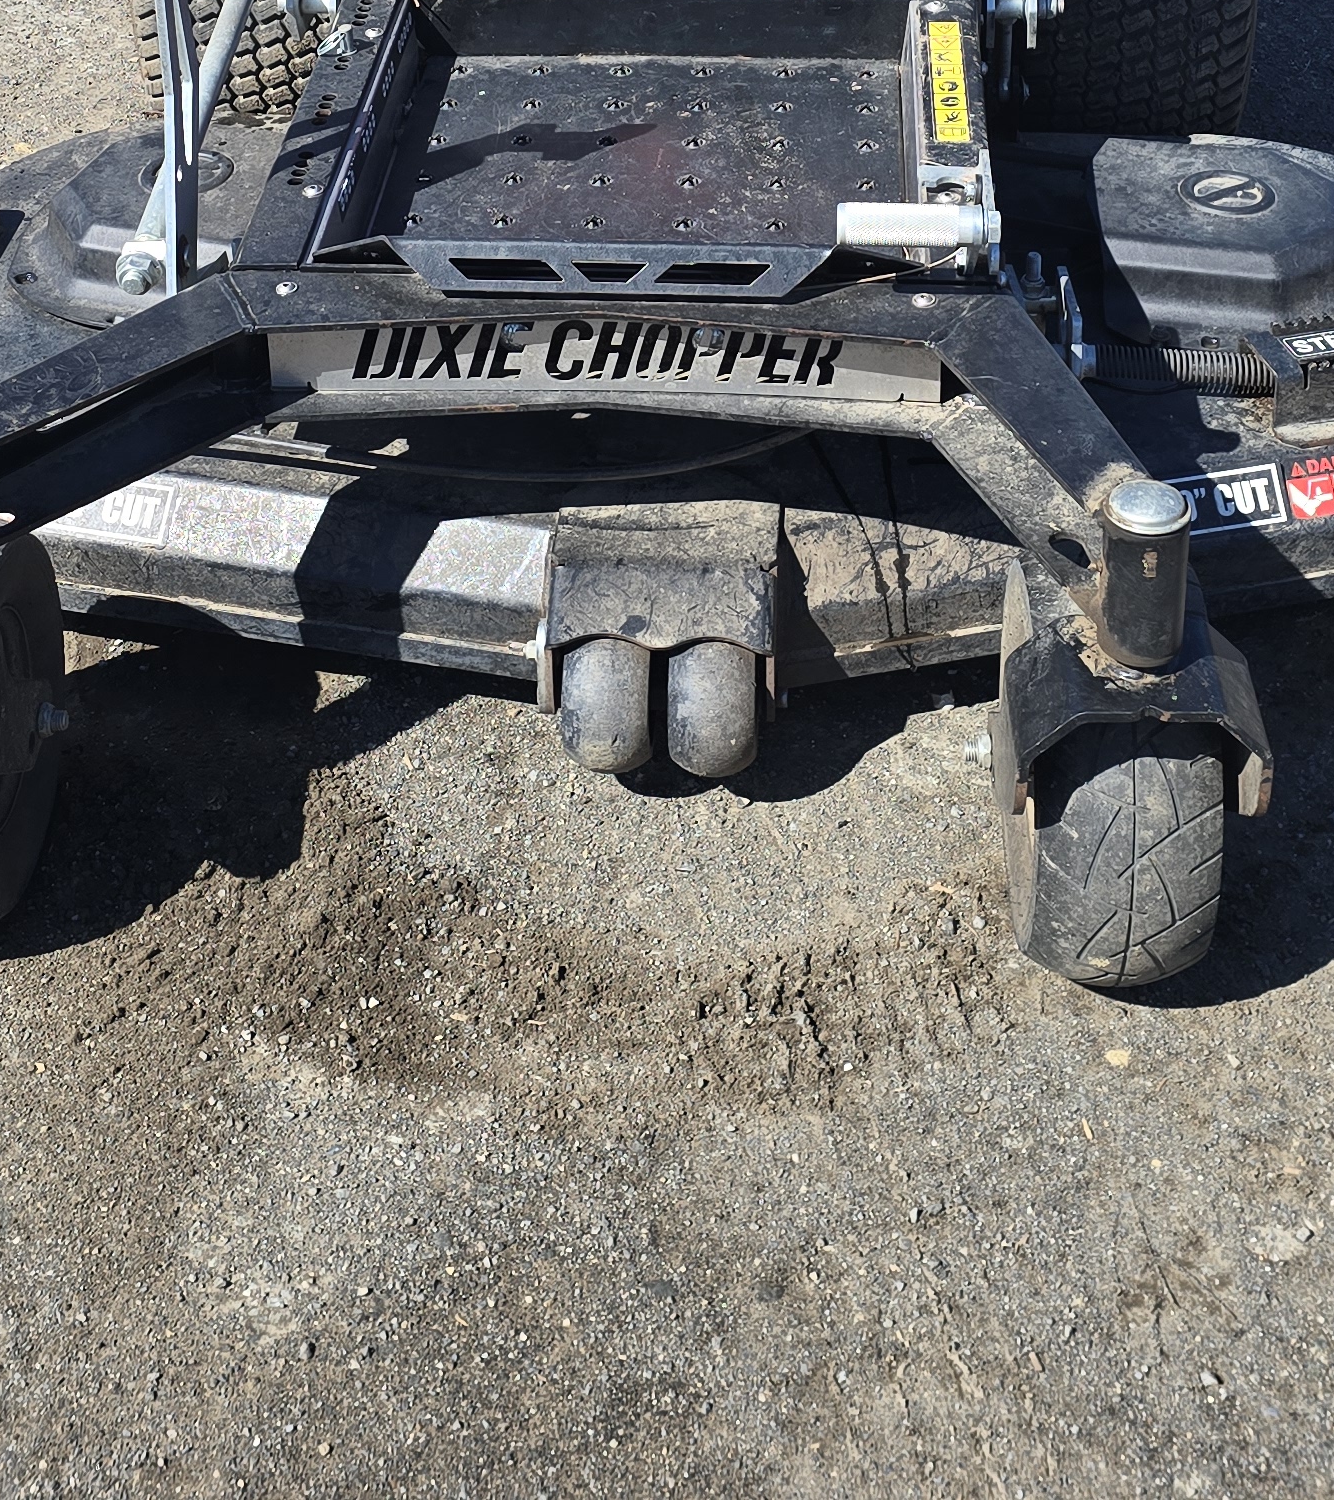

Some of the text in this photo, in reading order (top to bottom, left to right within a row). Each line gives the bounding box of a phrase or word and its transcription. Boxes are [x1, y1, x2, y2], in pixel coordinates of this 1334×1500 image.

[352, 319, 844, 387] DIXIE CHOPPER
[101, 490, 162, 530] CUT
[1214, 477, 1270, 518] CUT
